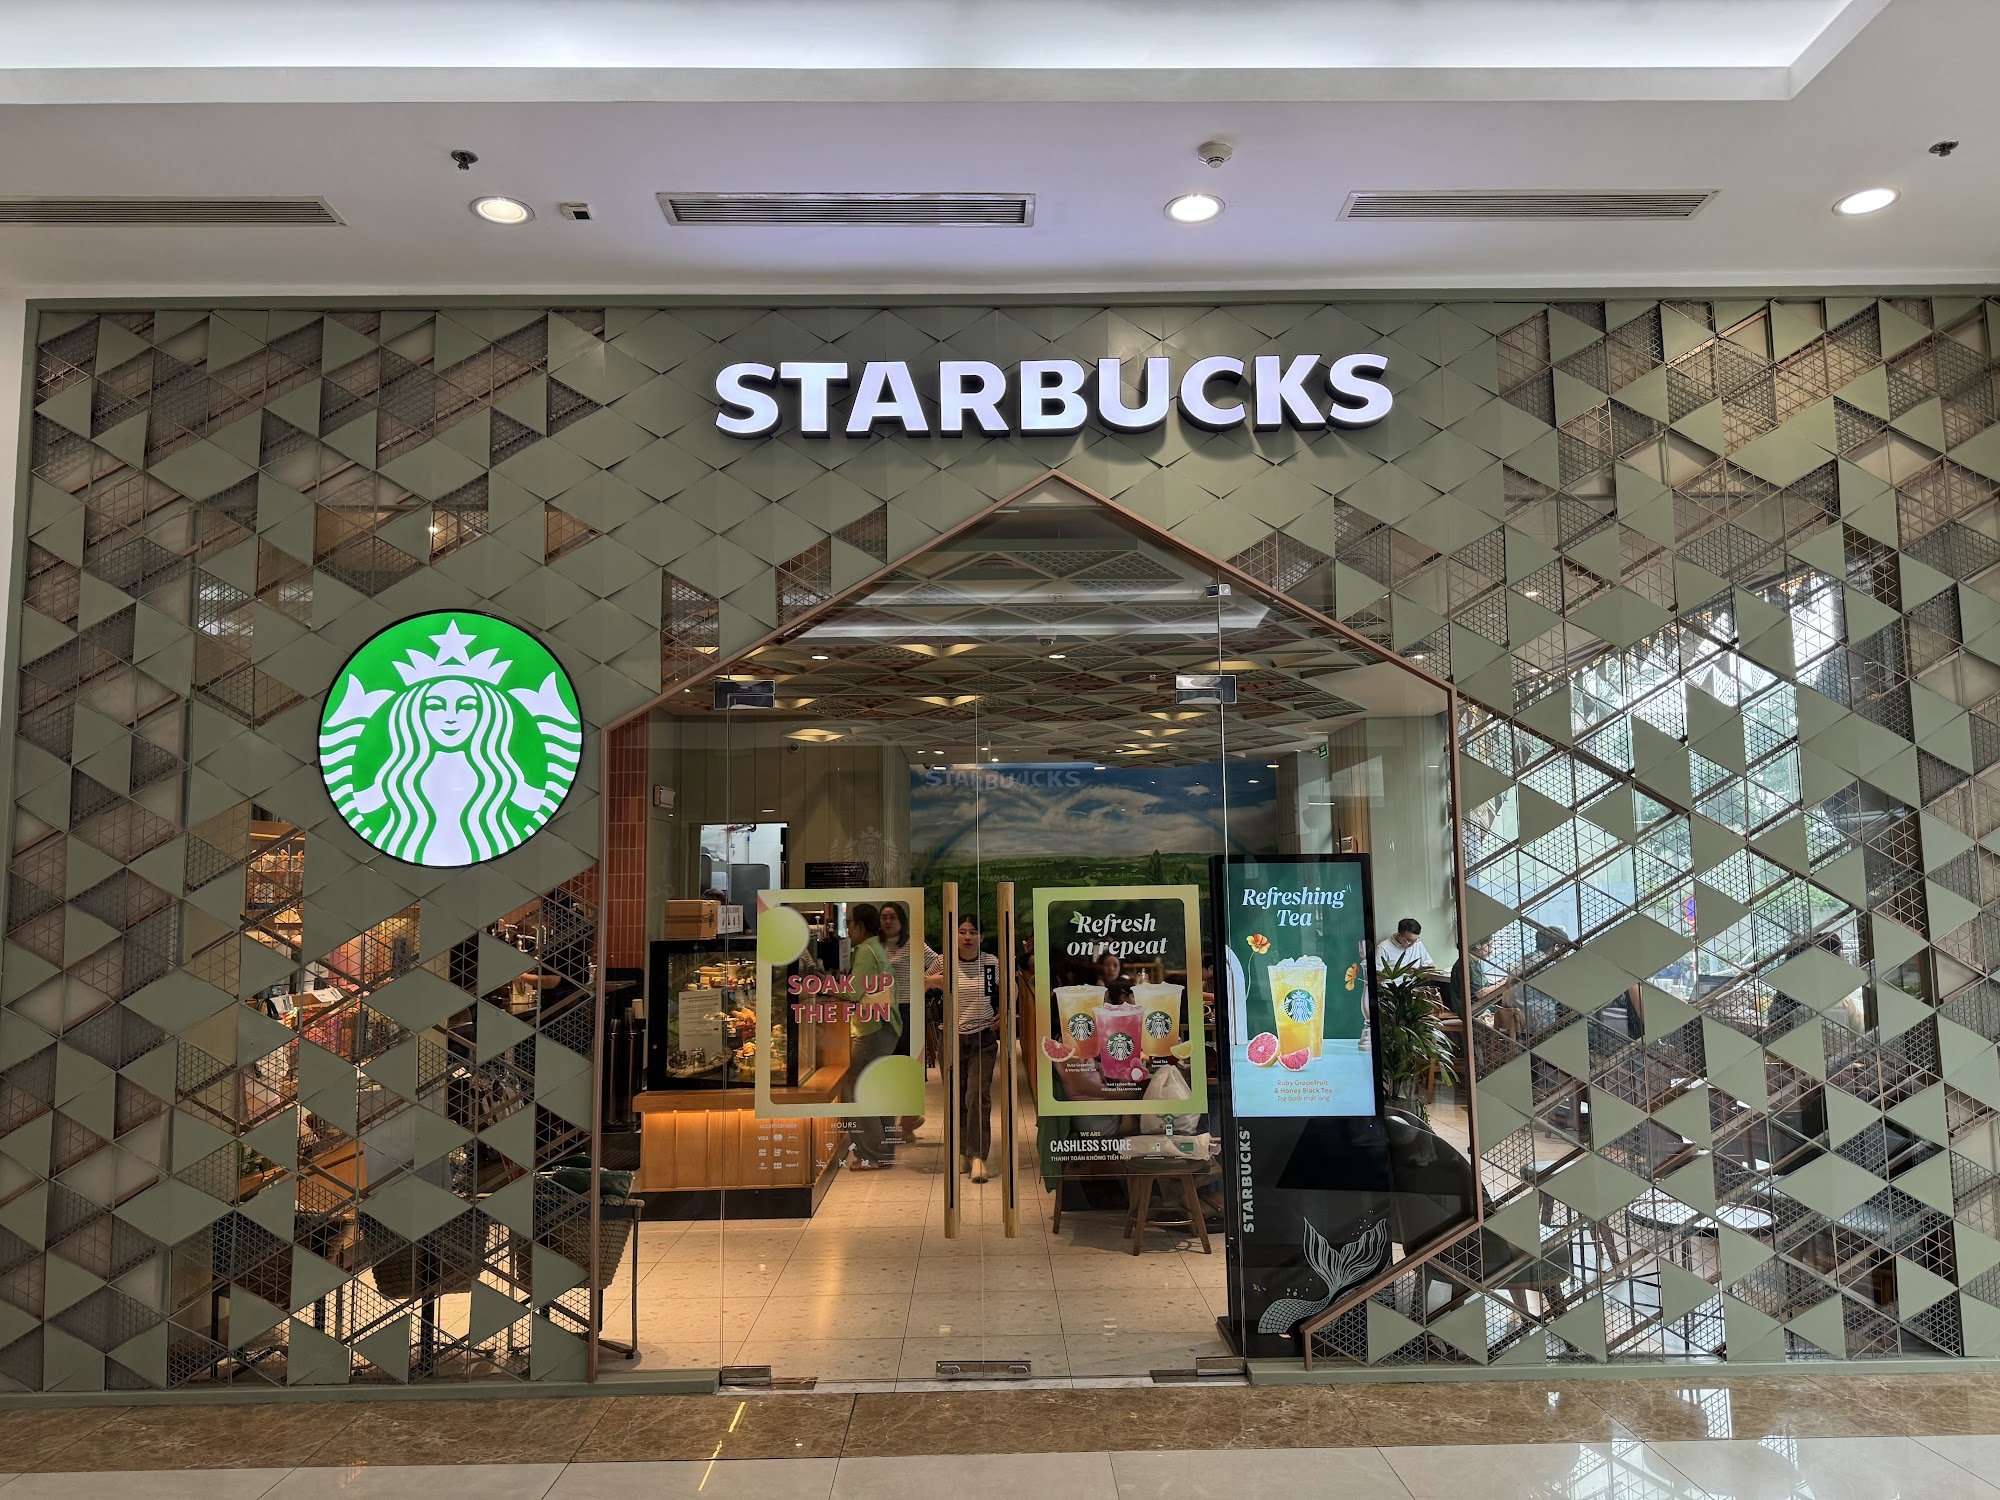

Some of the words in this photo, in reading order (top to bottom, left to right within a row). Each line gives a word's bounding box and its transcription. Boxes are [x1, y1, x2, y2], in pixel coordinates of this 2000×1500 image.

[714, 353, 1394, 438] STARBUCKS
[1242, 886, 1345, 909] Refreshing
[1076, 912, 1157, 937] Refresh
[1277, 909, 1313, 927] Tea
[1066, 941, 1094, 956] on
[1098, 937, 1169, 959] repeat
[787, 974, 857, 995] SOAK
[861, 974, 895, 994] UP
[790, 1003, 837, 1024] THE
[843, 1002, 891, 1023] FUN
[830, 1121, 857, 1129] HOURS
[1050, 1139, 1100, 1153] CASHLESS
[1100, 1138, 1132, 1151] STORE
[1239, 1130, 1255, 1233] STARBUCKS
